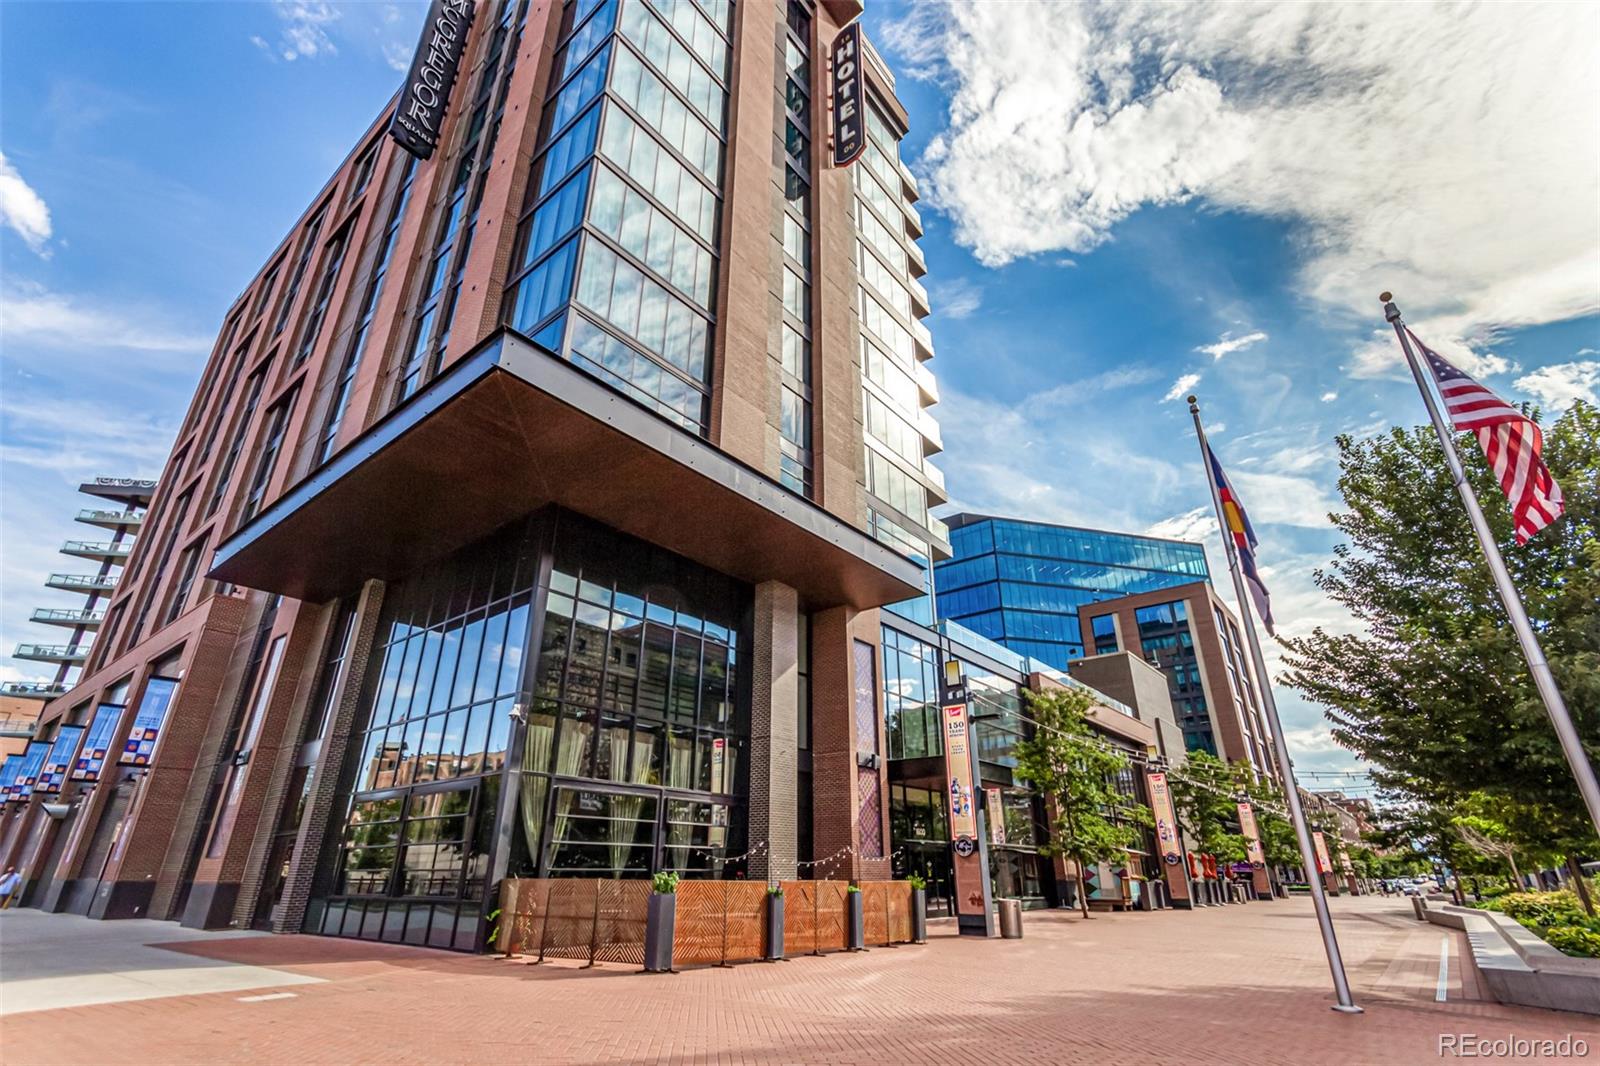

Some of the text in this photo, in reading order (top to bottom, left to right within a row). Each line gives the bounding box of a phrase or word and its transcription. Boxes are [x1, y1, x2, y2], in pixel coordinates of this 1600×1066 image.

[836, 40, 856, 143] HOTEL
[397, 115, 433, 145] SQUARE
[948, 720, 964, 730] 150
